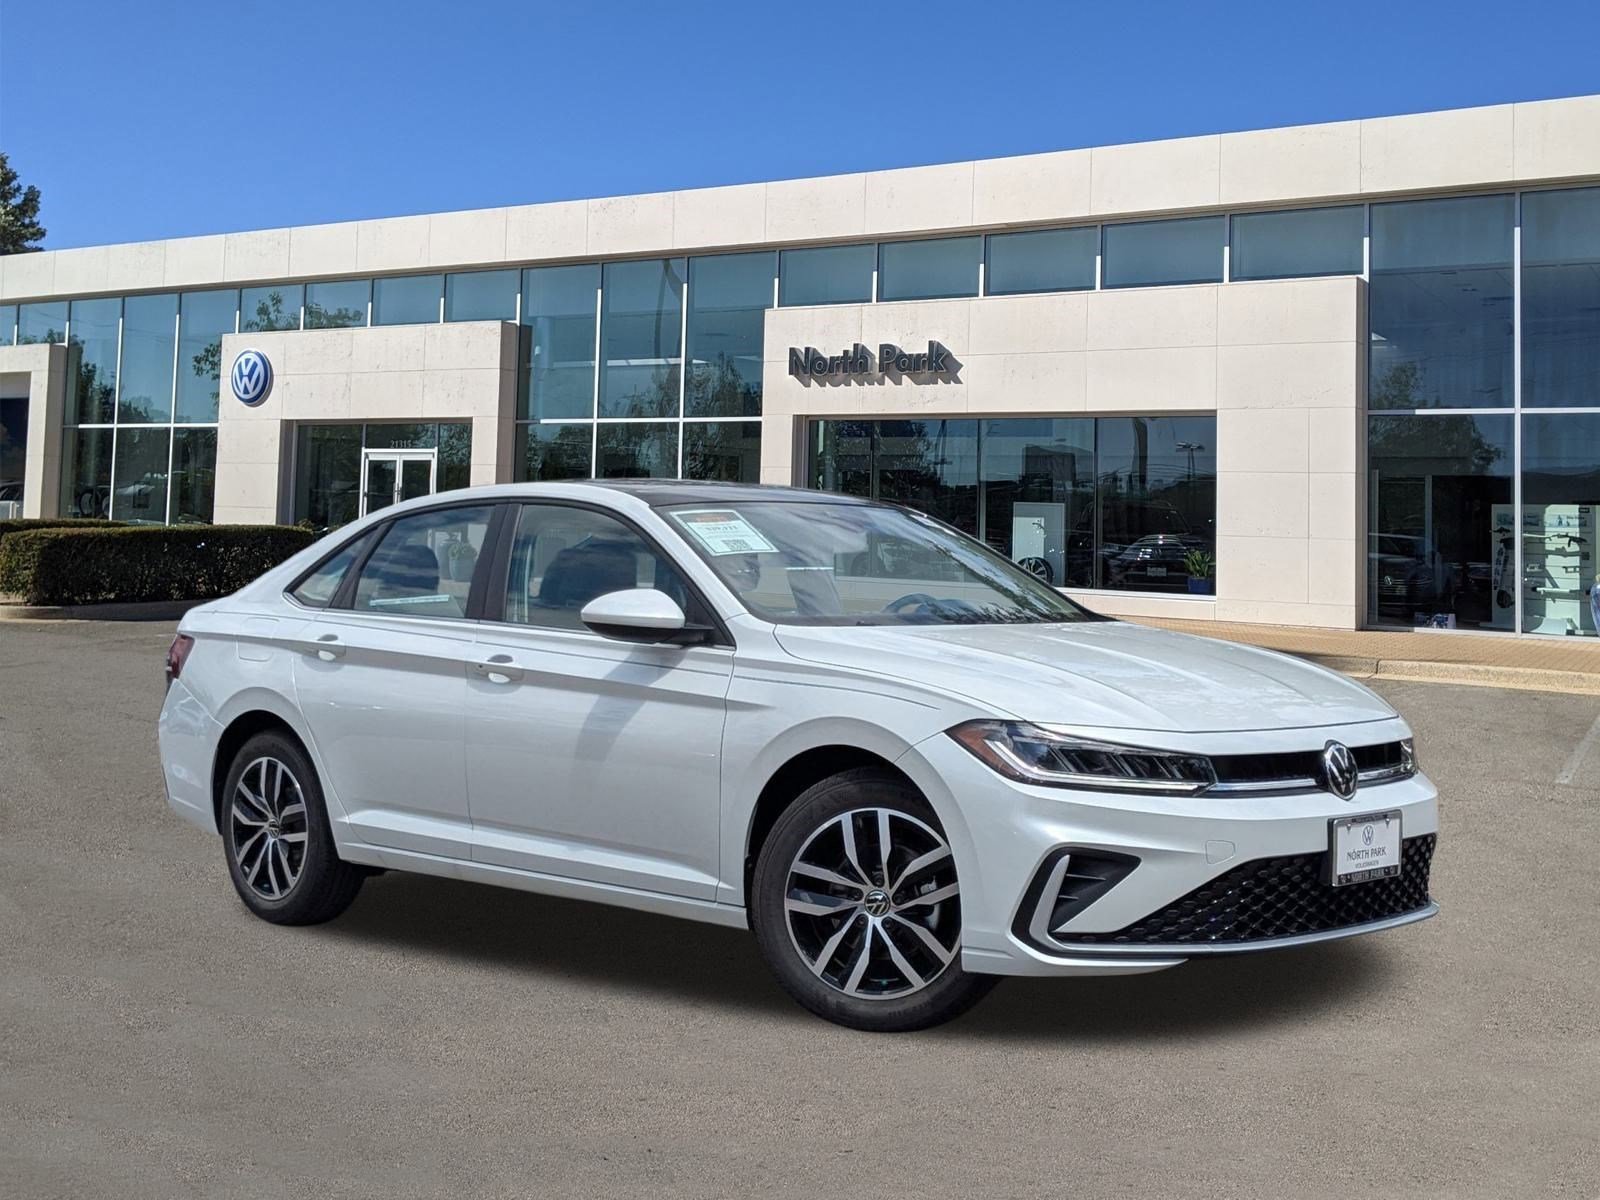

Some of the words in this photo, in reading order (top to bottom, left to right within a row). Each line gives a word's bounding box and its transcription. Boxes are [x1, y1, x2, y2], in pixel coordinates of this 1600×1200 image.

[788, 343, 873, 376] North
[878, 340, 949, 374] Park
[389, 439, 412, 448] 21315
[1347, 849, 1369, 861] NORTH
[1371, 846, 1387, 858] PARK
